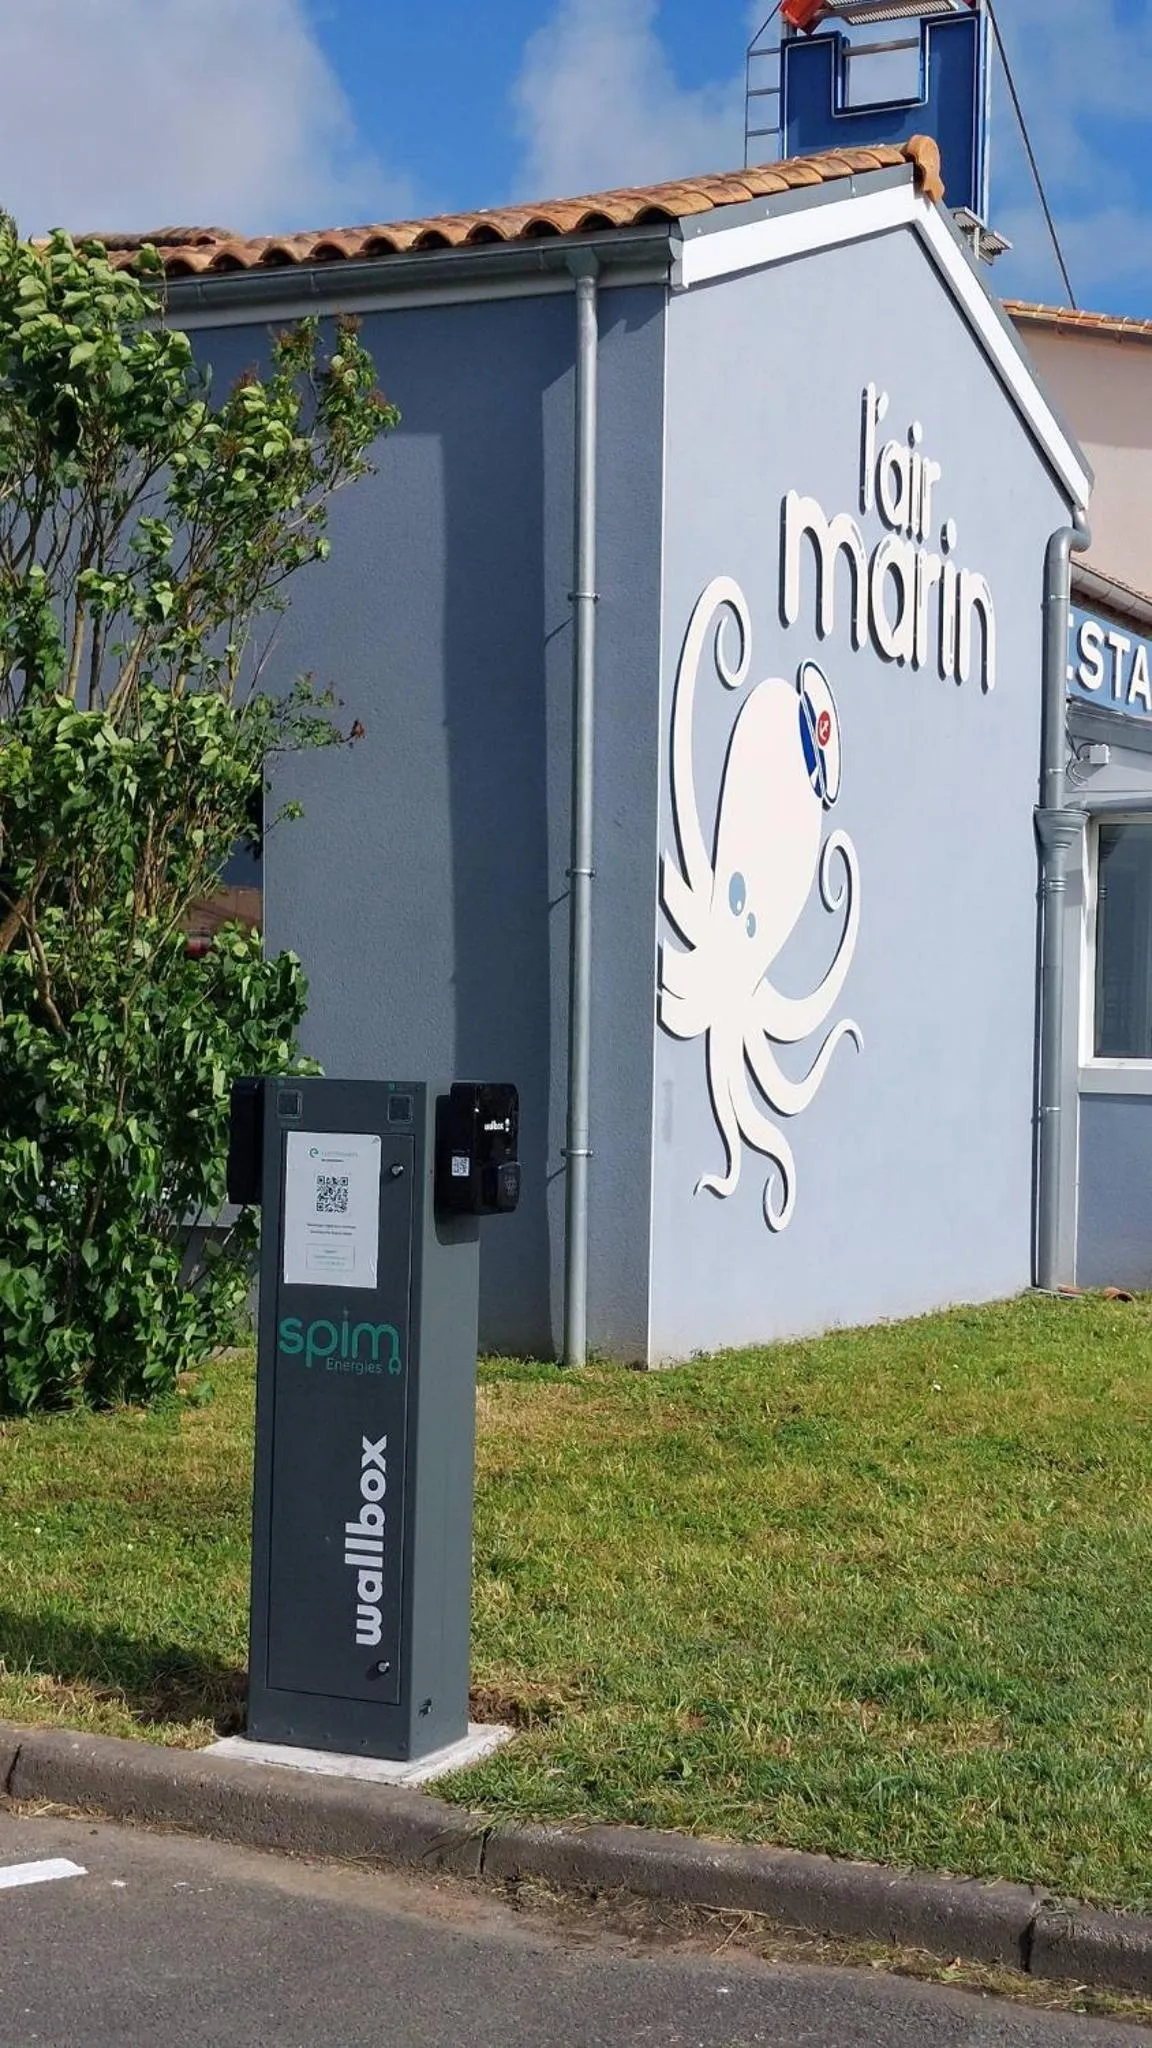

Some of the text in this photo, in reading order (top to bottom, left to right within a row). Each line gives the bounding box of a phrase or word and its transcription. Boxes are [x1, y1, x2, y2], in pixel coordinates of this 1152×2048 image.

[862, 382, 941, 540] l'air
[781, 489, 996, 692] marin
[1067, 612, 1152, 711] STA
[278, 1308, 402, 1375] spim
[326, 1357, 383, 1374] Energies
[345, 1434, 388, 1646] wallbox
